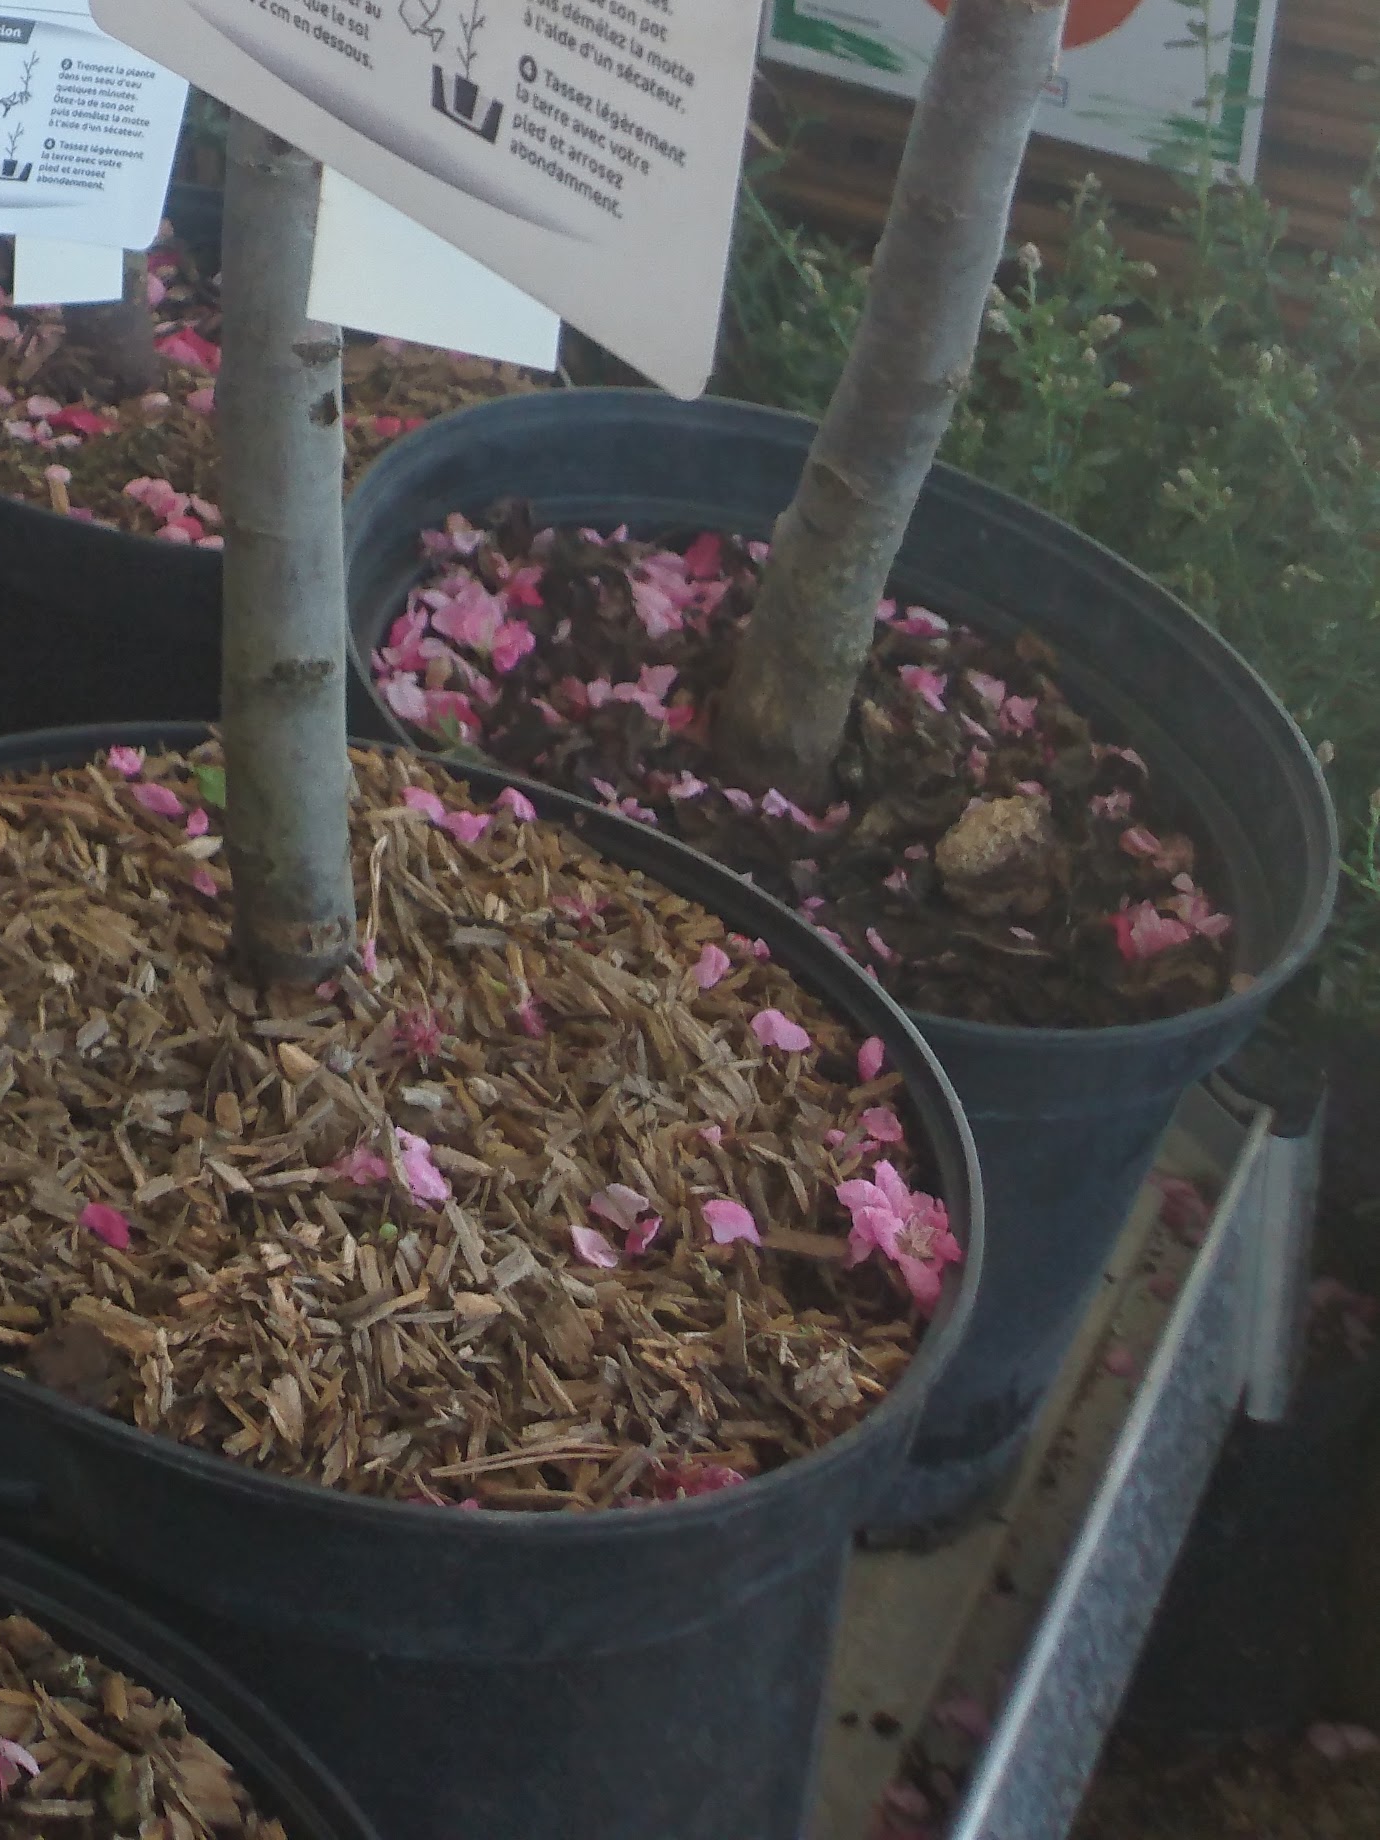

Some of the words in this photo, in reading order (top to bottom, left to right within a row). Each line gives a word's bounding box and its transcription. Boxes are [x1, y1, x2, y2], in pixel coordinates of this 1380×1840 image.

[332, 5, 345, 27] le
[348, 20, 370, 41] sol
[365, 3, 382, 20] au
[270, 3, 290, 22] cm
[294, 14, 310, 34] en
[314, 26, 374, 70] dessous.
